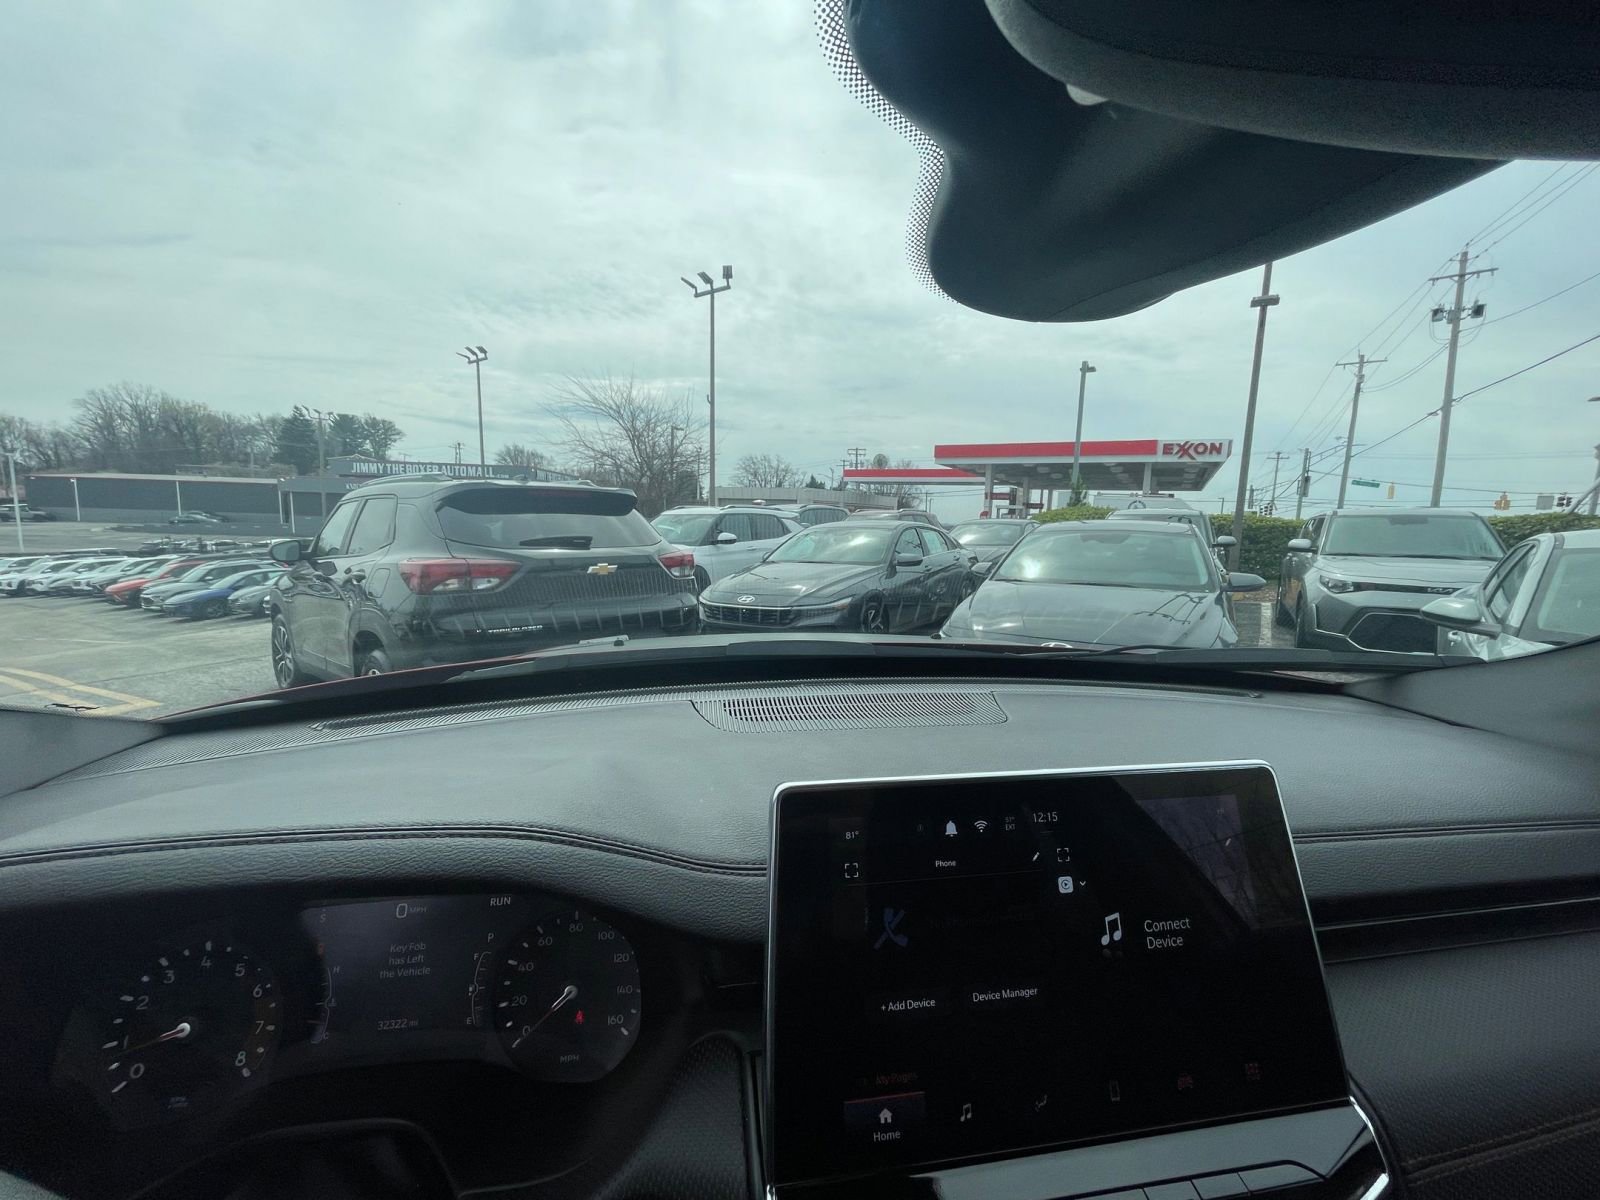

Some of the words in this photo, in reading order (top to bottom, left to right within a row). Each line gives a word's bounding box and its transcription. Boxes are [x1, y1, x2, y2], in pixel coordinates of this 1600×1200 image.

[1162, 441, 1222, 460] EXXON
[352, 463, 384, 474] JIMMY
[386, 464, 405, 475] THE
[406, 464, 438, 474] BOXER
[441, 465, 495, 478] AUTOMALL
[1033, 811, 1058, 823] 12:15
[845, 830, 860, 840] 81°
[935, 859, 957, 868] Phone
[490, 897, 511, 906] RUN
[396, 903, 408, 919] 0
[569, 922, 584, 933] 80
[1144, 917, 1191, 933] Connect
[487, 932, 495, 943] P
[537, 936, 553, 947] 60
[598, 931, 615, 940] 100
[390, 943, 409, 954] Key
[409, 941, 427, 951] Fob
[1146, 935, 1184, 950] Device
[201, 956, 212, 968] 4
[389, 956, 405, 966] has
[407, 954, 425, 965] Left
[613, 953, 630, 963] 120
[235, 963, 246, 977] 5
[380, 969, 395, 979] the
[397, 966, 431, 978] Vehicle
[518, 961, 534, 972] 40
[163, 969, 175, 984] 3
[253, 983, 263, 998] 6
[972, 991, 1001, 1003] Device
[1002, 987, 1039, 1001] Manager
[136, 995, 149, 1011] 2
[511, 995, 528, 1007] 20
[907, 997, 937, 1010] Device
[377, 1018, 408, 1031] 32322
[607, 1014, 624, 1025] 160
[255, 1020, 264, 1035] 7
[235, 1050, 246, 1066] 8
[560, 1054, 580, 1064] MPH
[129, 1062, 145, 1079] 0
[873, 1131, 902, 1143] Home
